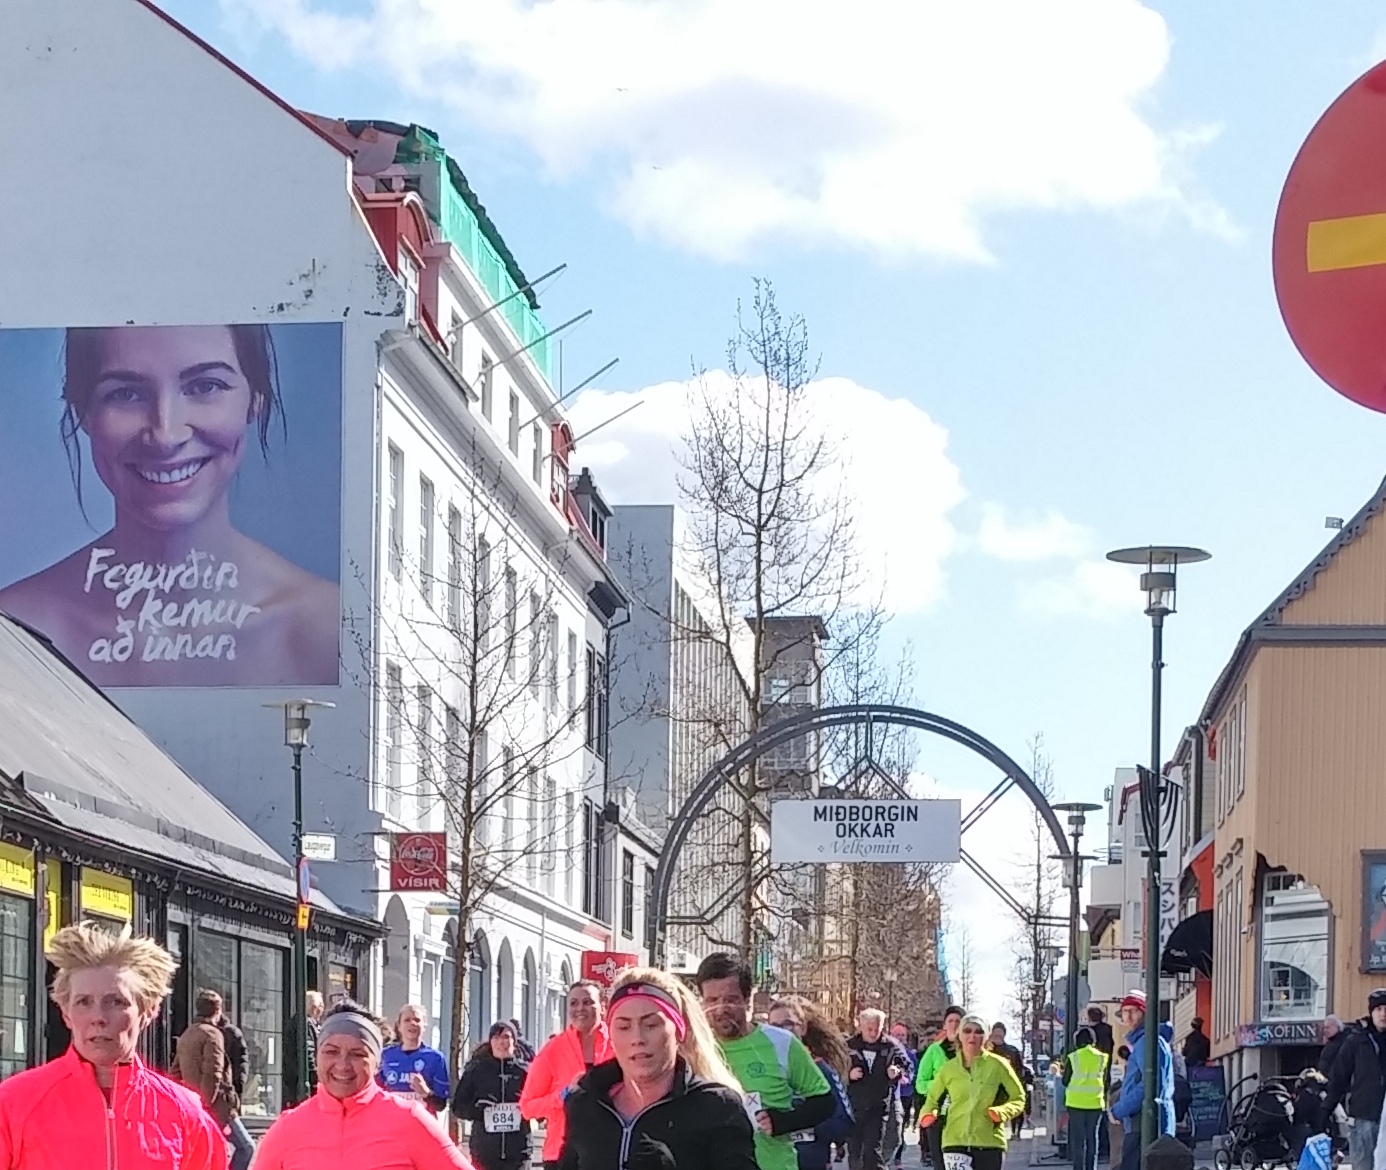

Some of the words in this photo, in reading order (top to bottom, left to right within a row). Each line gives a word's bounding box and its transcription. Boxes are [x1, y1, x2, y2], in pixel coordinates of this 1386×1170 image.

[84, 548, 238, 609] Fegurðin
[138, 589, 261, 632] kemur
[89, 615, 135, 663] að
[140, 626, 236, 662] innan
[813, 805, 919, 822] MIÐBORGIN
[835, 822, 895, 838] OKKAR
[830, 838, 900, 857] Velkomin
[397, 876, 440, 888] VÍSIR
[493, 1112, 514, 1123] 684
